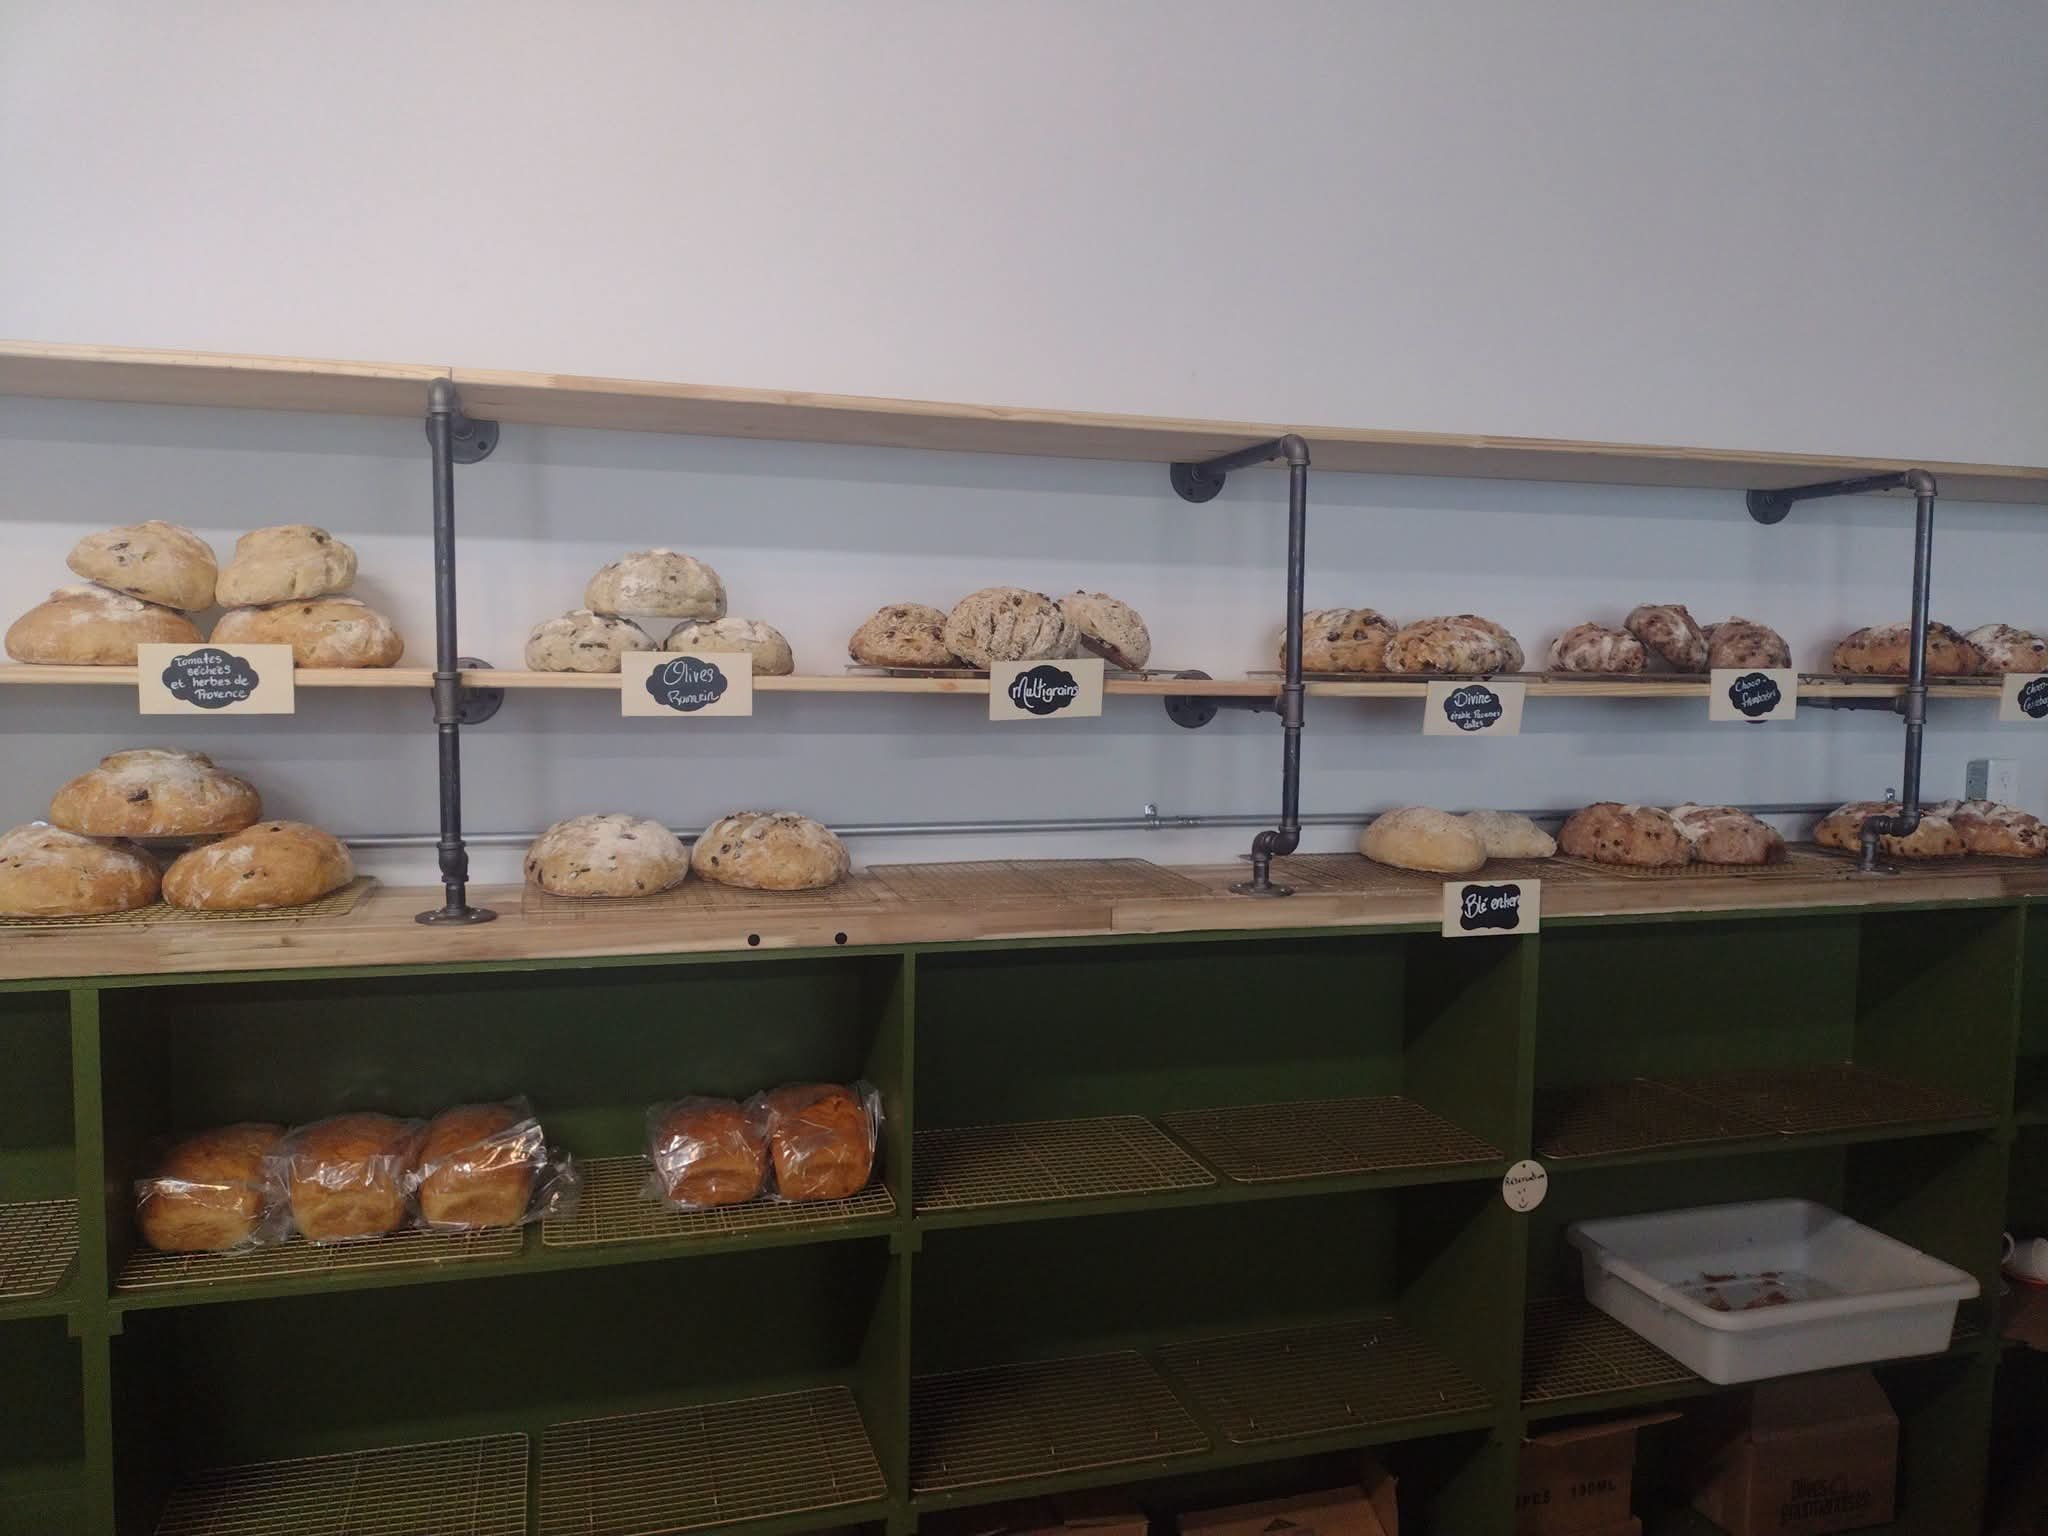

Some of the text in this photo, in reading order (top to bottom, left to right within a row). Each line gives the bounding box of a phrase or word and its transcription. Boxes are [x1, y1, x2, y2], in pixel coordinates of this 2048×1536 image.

[174, 652, 223, 667] Tomates
[663, 660, 714, 686] Olives
[170, 675, 249, 690] et herbes de
[194, 688, 248, 700] Provence
[1012, 676, 1079, 708] Multigrains
[1453, 692, 1492, 707] Divine
[1464, 893, 1489, 919] Blé
